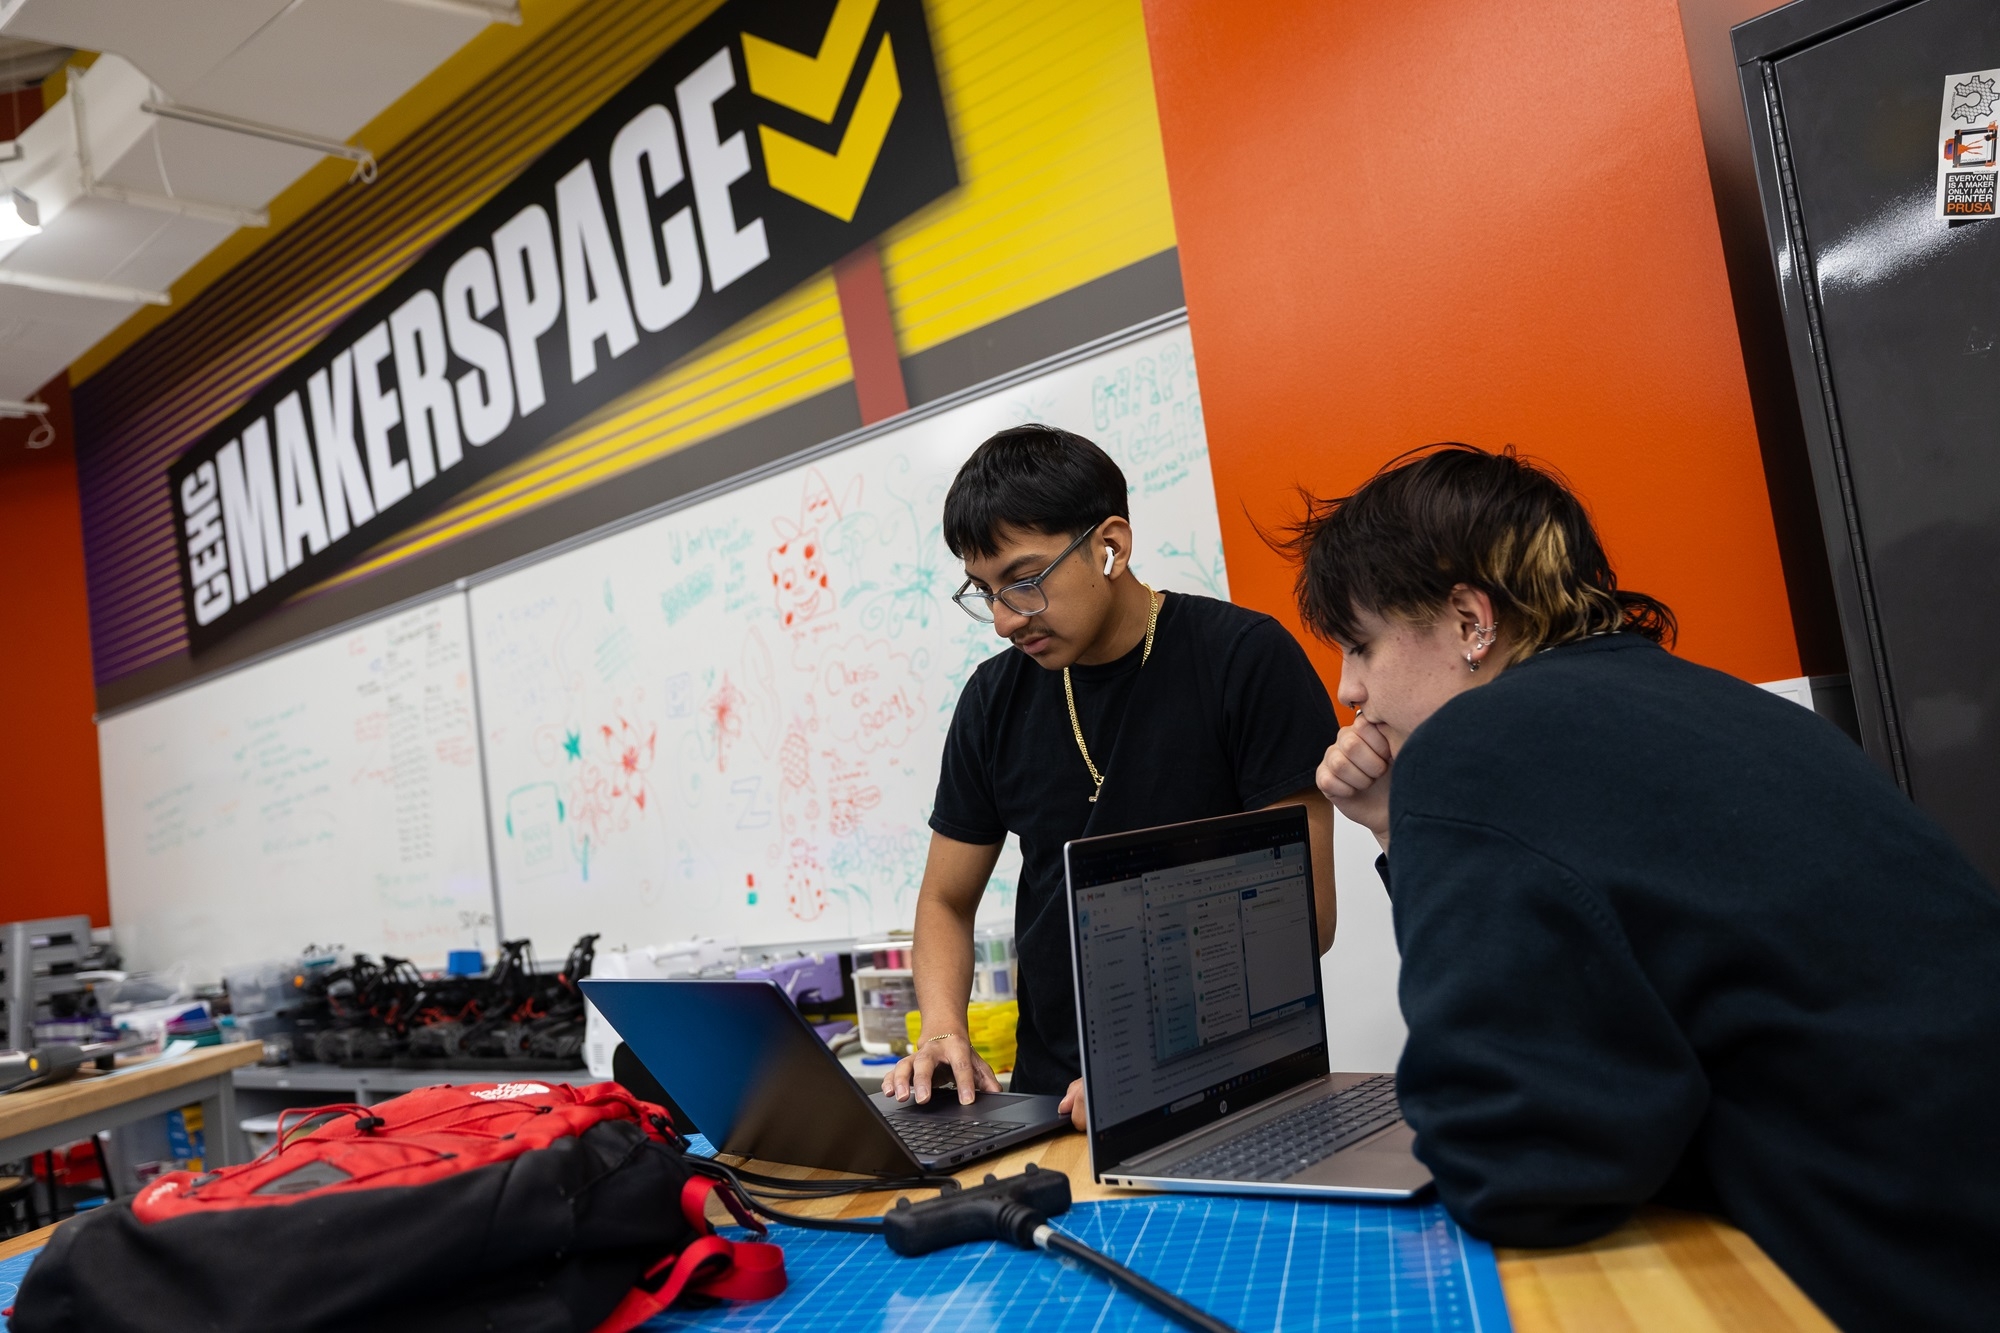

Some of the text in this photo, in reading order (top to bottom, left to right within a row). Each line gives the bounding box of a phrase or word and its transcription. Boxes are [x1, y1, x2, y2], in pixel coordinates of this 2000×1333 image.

[1948, 174, 1995, 182] EVERYONE
[1957, 181, 1964, 189] A
[1965, 180, 1994, 188] MAKER
[1947, 194, 1993, 203] PRINTER
[1946, 202, 1993, 213] PRUSA
[214, 45, 771, 606] MAKERSPACE
[180, 459, 234, 627] CEHC
